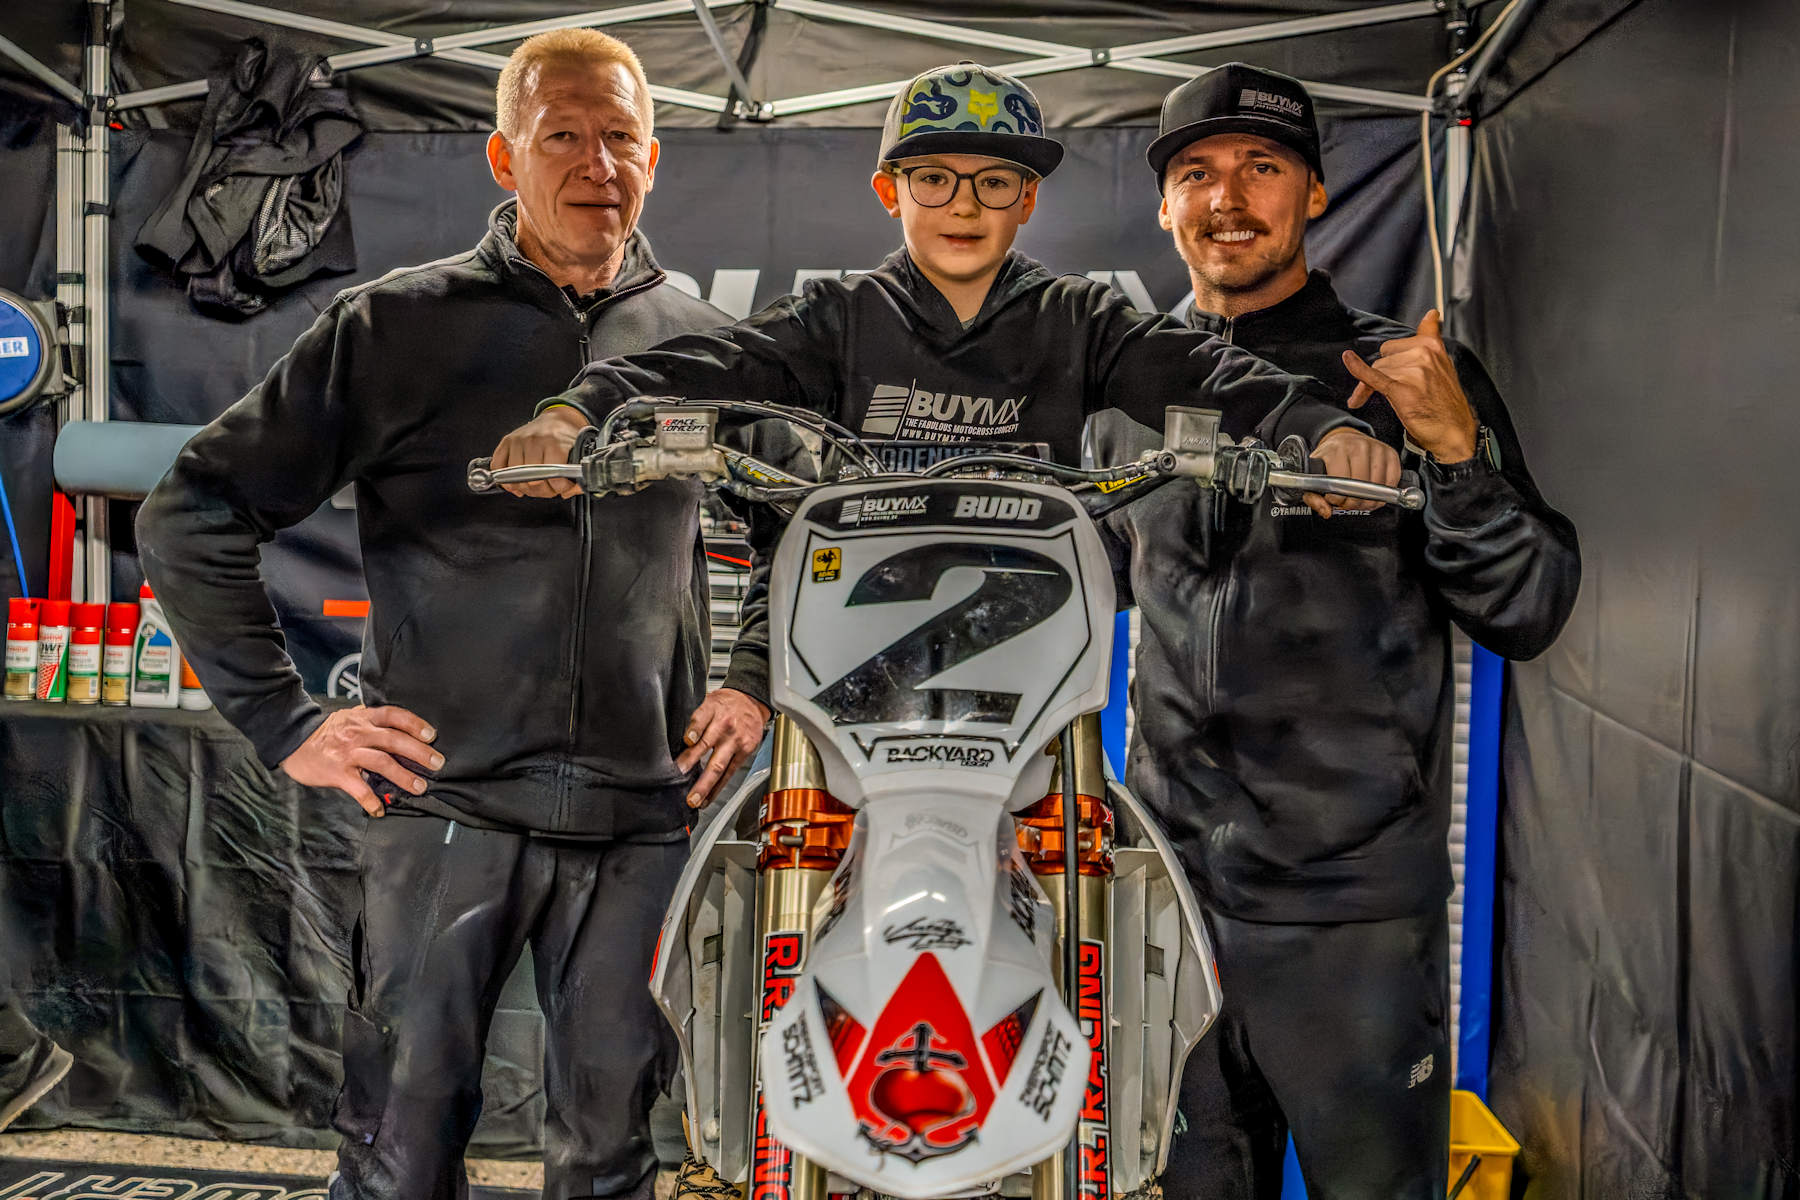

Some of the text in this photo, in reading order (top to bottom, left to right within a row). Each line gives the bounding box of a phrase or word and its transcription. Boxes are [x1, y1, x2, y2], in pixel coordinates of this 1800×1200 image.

[1257, 91, 1303, 112] BUYMX
[0, 341, 24, 353] ER
[908, 389, 1027, 425] BUYMX
[905, 418, 1020, 436] THE FABULOUS MOTOCROSS CONCEPT
[863, 495, 931, 512] BUYMX
[953, 496, 1043, 521] BUDD
[1280, 506, 1313, 516] YAMAHA
[809, 541, 1074, 728] 2
[886, 745, 994, 763] BACKYARD
[960, 759, 991, 768] DESIGN
